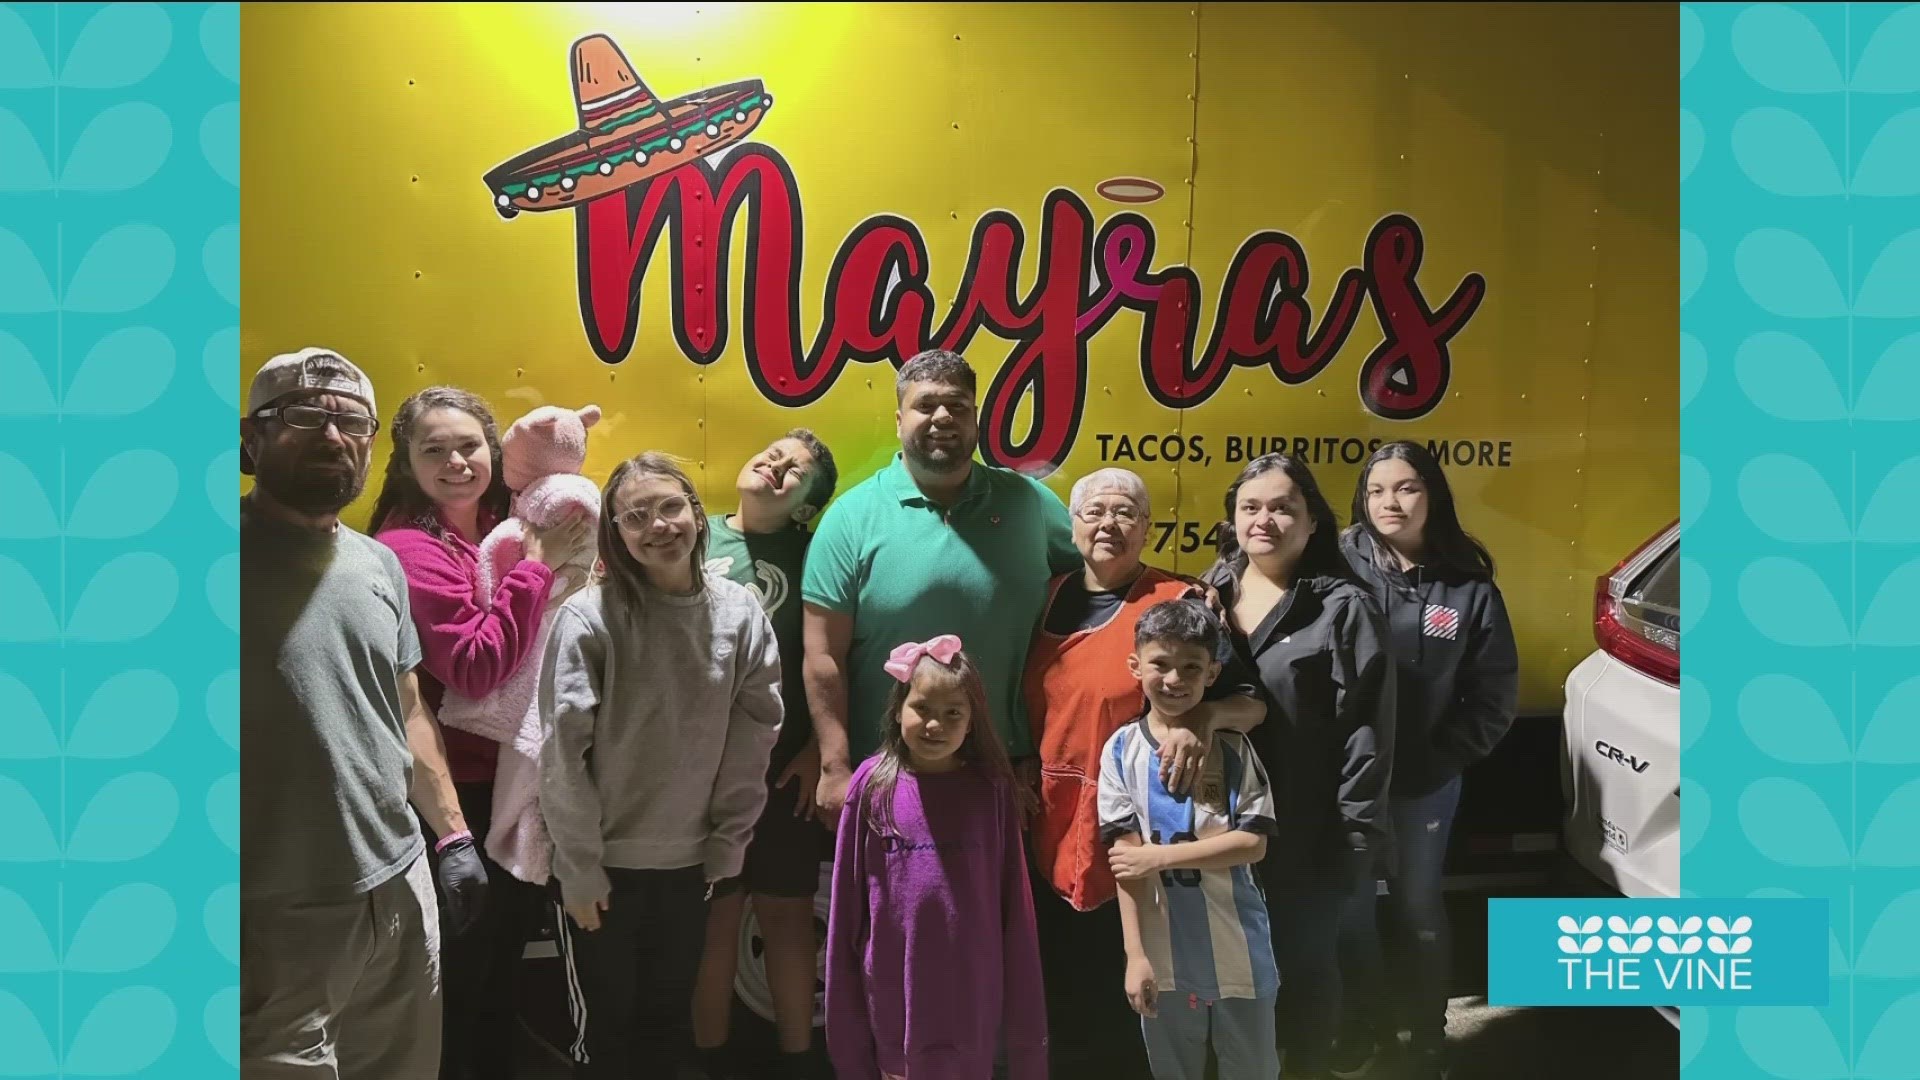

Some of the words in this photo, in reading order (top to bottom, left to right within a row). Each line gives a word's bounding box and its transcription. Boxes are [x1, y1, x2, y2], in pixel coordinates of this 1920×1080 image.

[575, 142, 1486, 476] Mayras
[1095, 434, 1212, 467] TACOS,
[1427, 439, 1512, 467] MORE
[1595, 740, 1650, 774] CR-V
